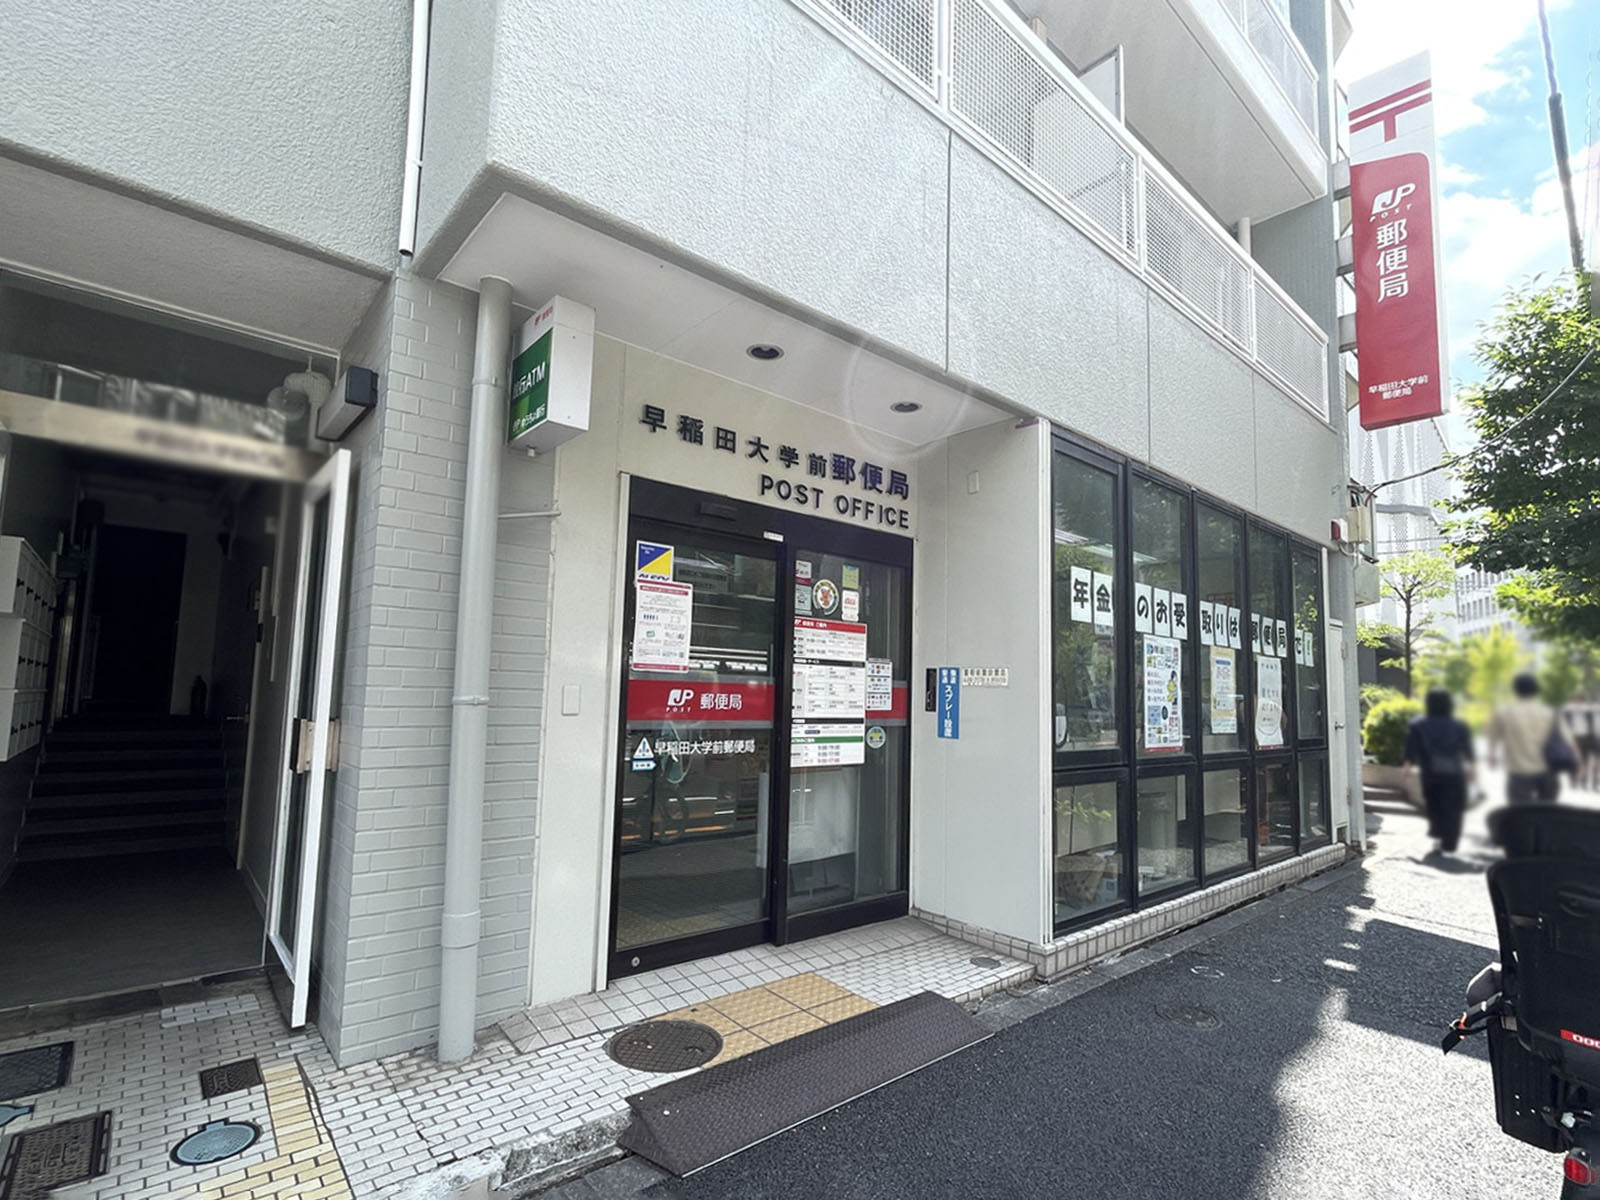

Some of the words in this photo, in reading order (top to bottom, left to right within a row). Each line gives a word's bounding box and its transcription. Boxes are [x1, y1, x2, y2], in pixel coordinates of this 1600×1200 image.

[1371, 183, 1416, 215] JP
[1376, 218, 1409, 303] 郵便局
[639, 404, 910, 500] 早稲田大学前郵便局
[760, 474, 823, 509] POST
[836, 495, 909, 529] OFFICE
[1073, 578, 1111, 613] 年金
[667, 689, 695, 706] JP
[700, 693, 742, 710] 郵便局
[654, 737, 756, 757] 早稲田大学前郵便局
